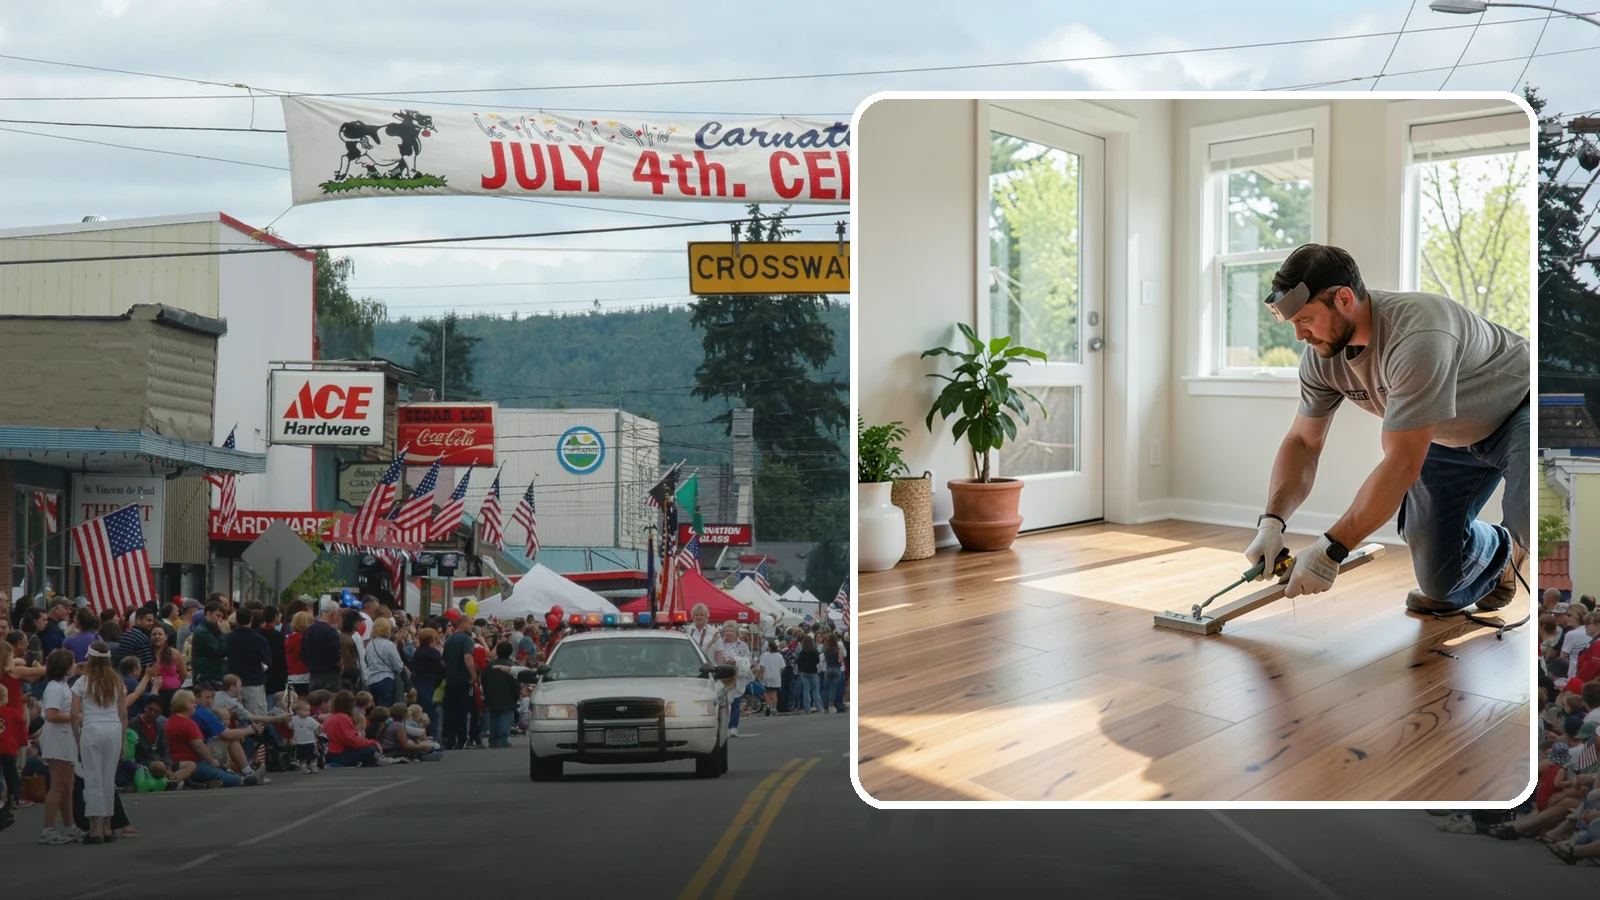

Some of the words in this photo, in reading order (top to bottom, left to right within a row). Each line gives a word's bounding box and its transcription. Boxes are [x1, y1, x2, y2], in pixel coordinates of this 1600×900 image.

[695, 121, 850, 150] Carnat
[481, 141, 604, 192] JULY
[632, 149, 746, 198] 4th.
[697, 254, 850, 280] CROSSWA
[282, 380, 373, 420] ACE
[405, 409, 452, 422] CEDAR
[283, 421, 371, 436] Hardware
[416, 428, 477, 447] Coca-Cola
[353, 467, 384, 480] Simpl
[95, 484, 124, 495] Vincent
[126, 486, 136, 495] de
[137, 486, 155, 495] Paul
[688, 526, 742, 535] CRNATION
[699, 535, 730, 543] GLASS
